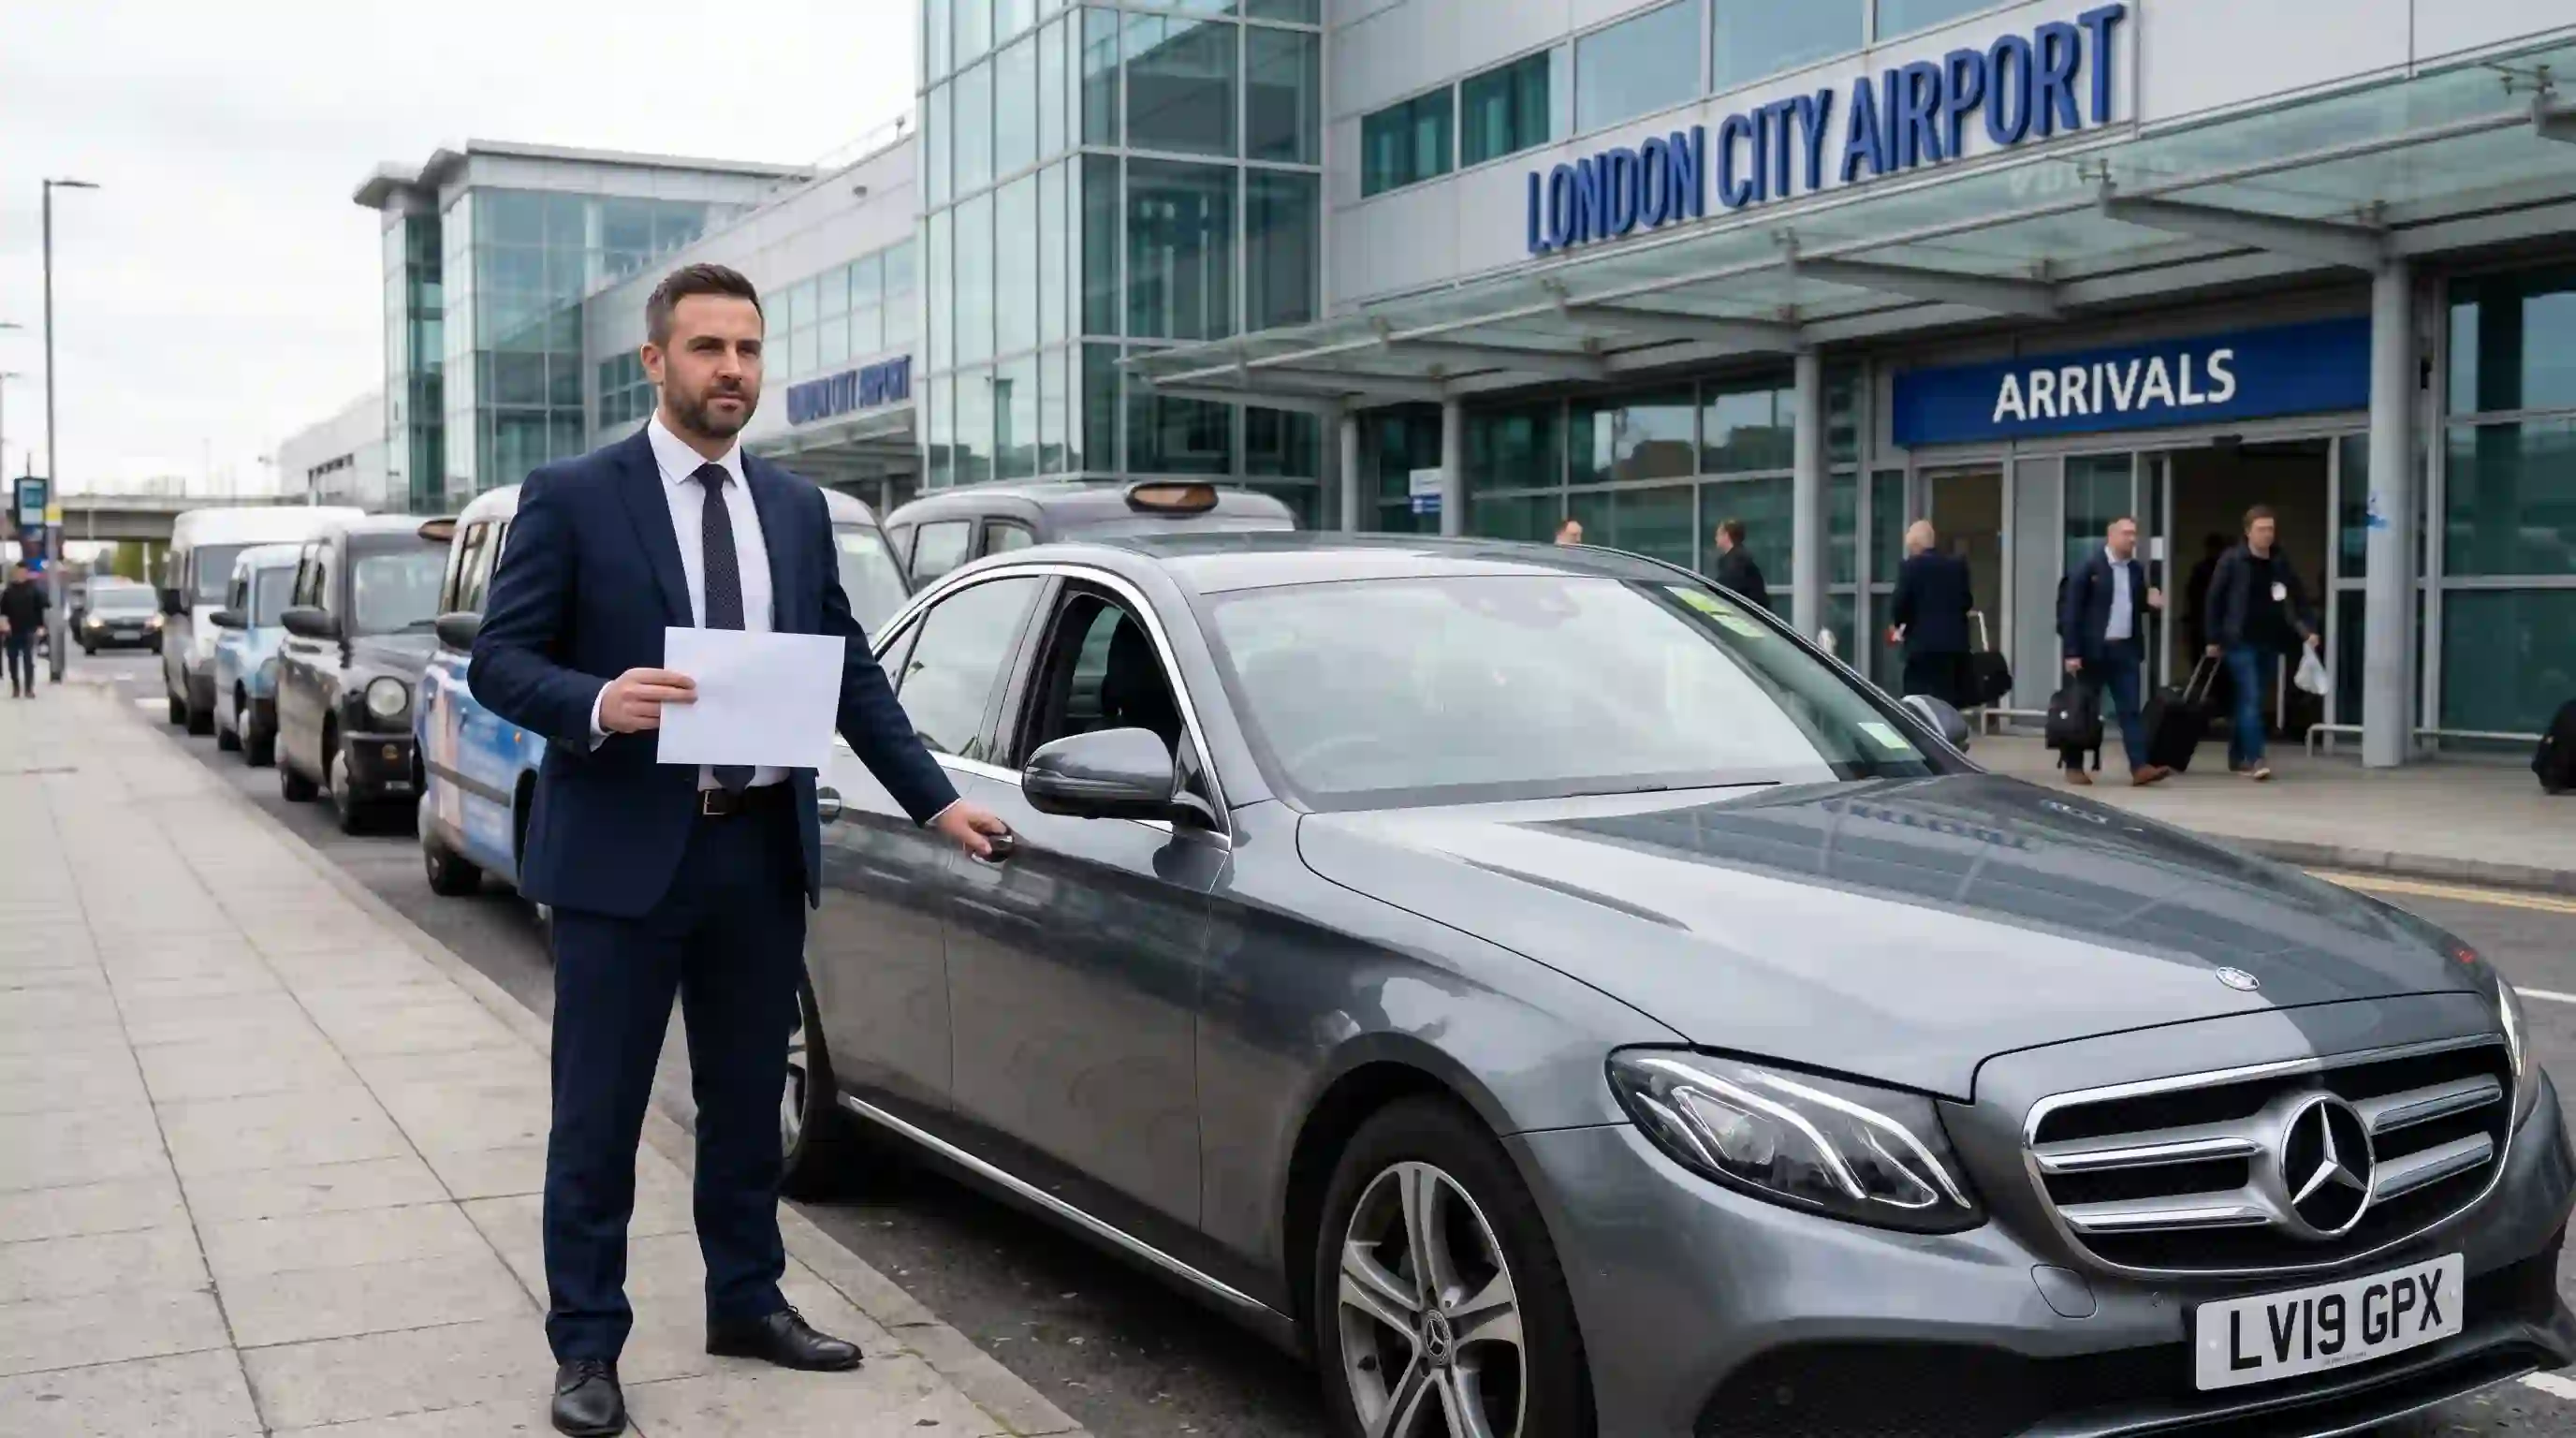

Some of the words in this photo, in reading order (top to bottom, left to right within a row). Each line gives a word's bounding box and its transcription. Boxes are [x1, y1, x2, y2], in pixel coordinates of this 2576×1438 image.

[1527, 125, 1705, 255] LONDON
[1716, 88, 1833, 208] CITY
[1839, 3, 2125, 183] AIRPORT
[1993, 348, 2236, 423] ARRIVALS
[2230, 1293, 2346, 1372] LV19
[2362, 1268, 2443, 1346] GPX
